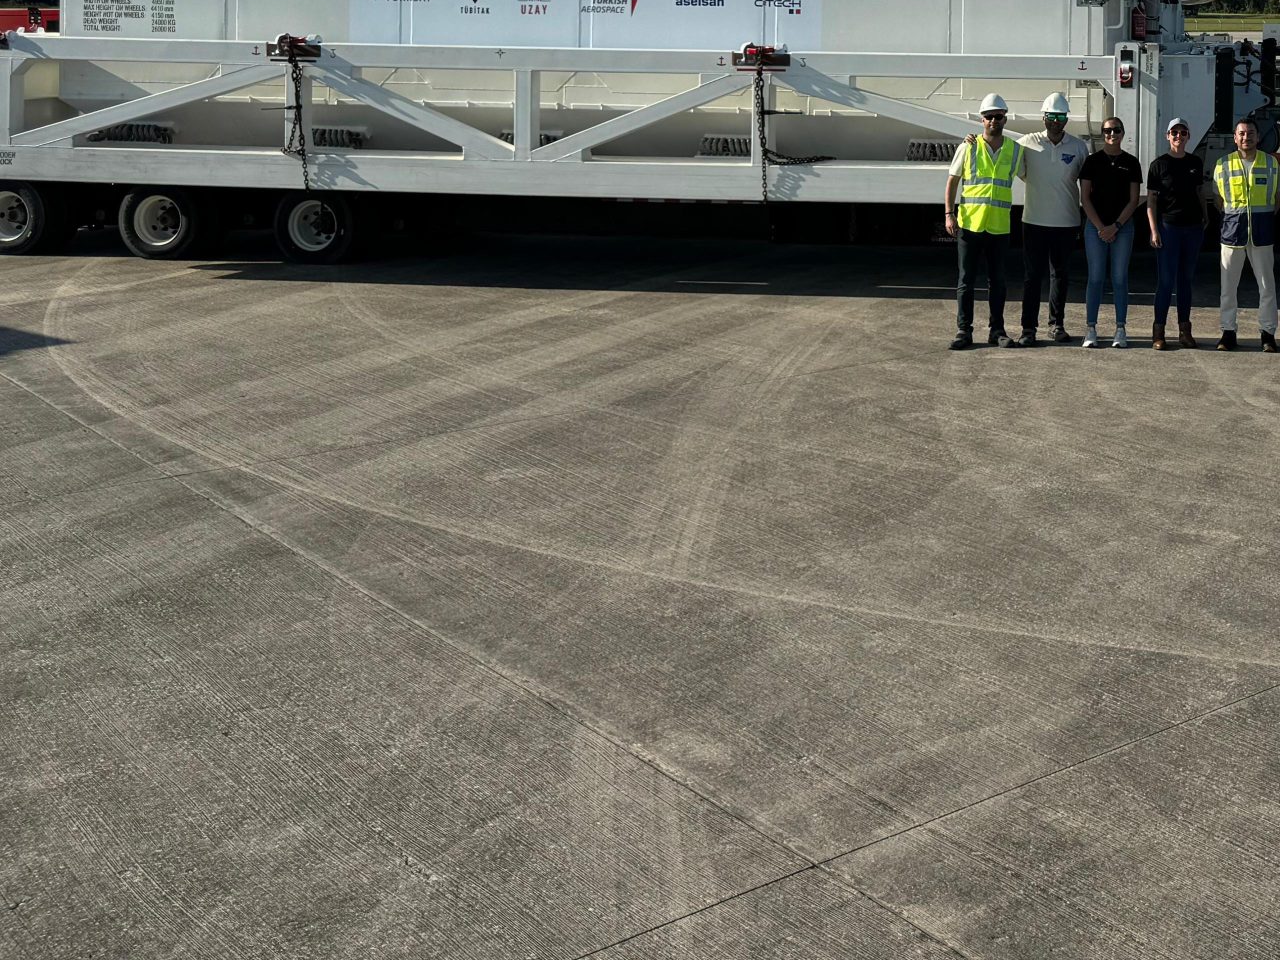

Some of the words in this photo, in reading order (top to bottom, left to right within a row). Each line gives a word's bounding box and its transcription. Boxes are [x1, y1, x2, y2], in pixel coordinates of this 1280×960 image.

[460, 6, 490, 14] TÜBİTAK
[521, 4, 547, 15] UZAY
[581, 6, 625, 14] AEROSPACE
